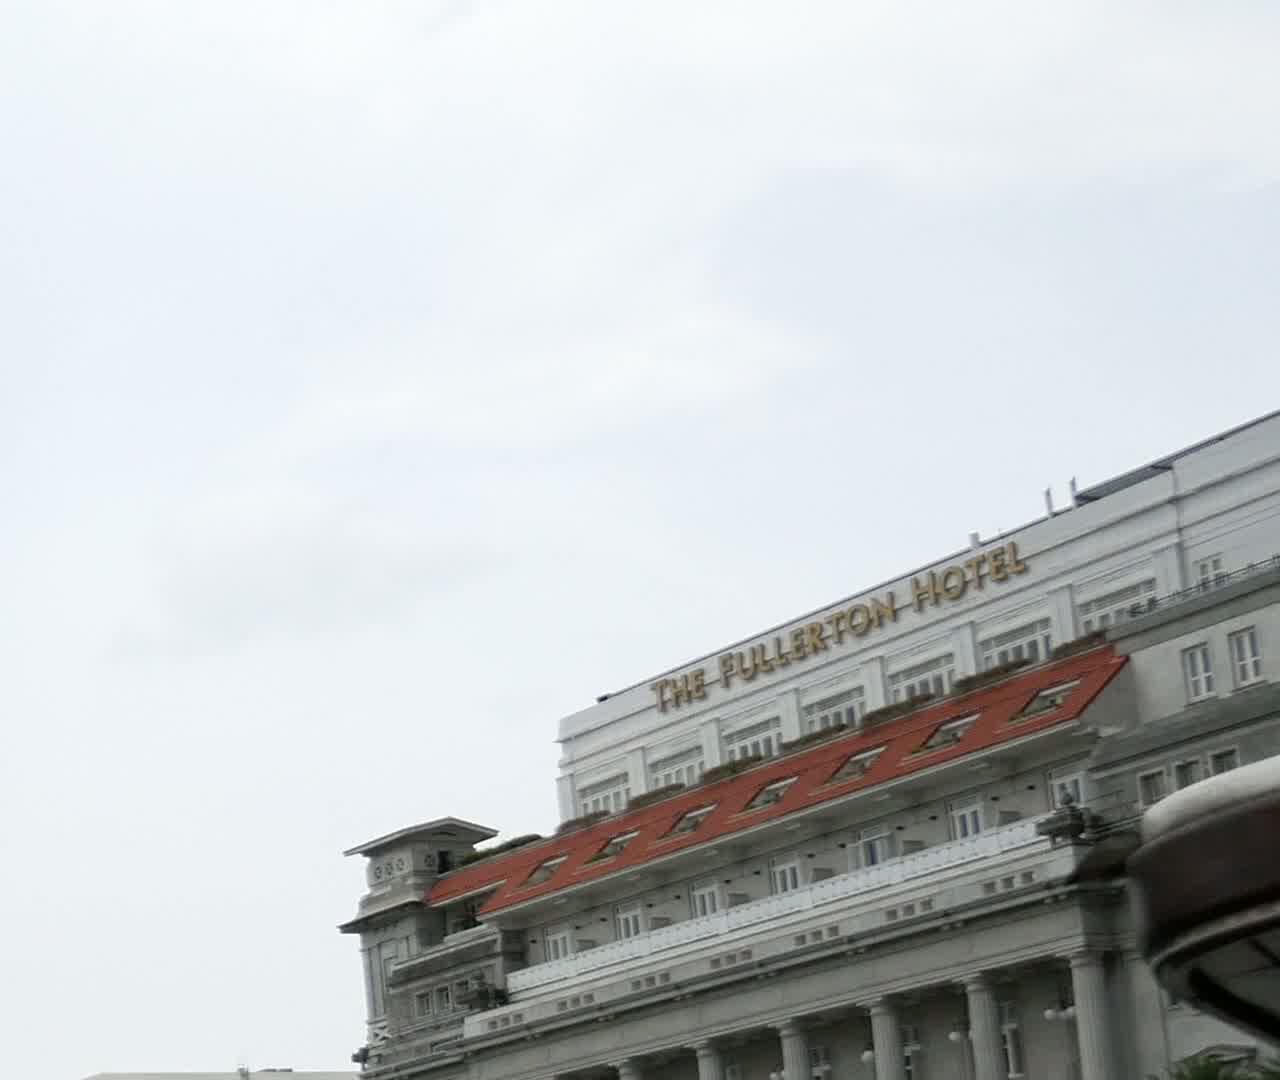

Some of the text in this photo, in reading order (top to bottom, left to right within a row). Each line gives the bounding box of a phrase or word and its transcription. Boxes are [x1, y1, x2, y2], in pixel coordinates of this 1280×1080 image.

[651, 541, 1027, 712] THE FULLERTON HOTEL
